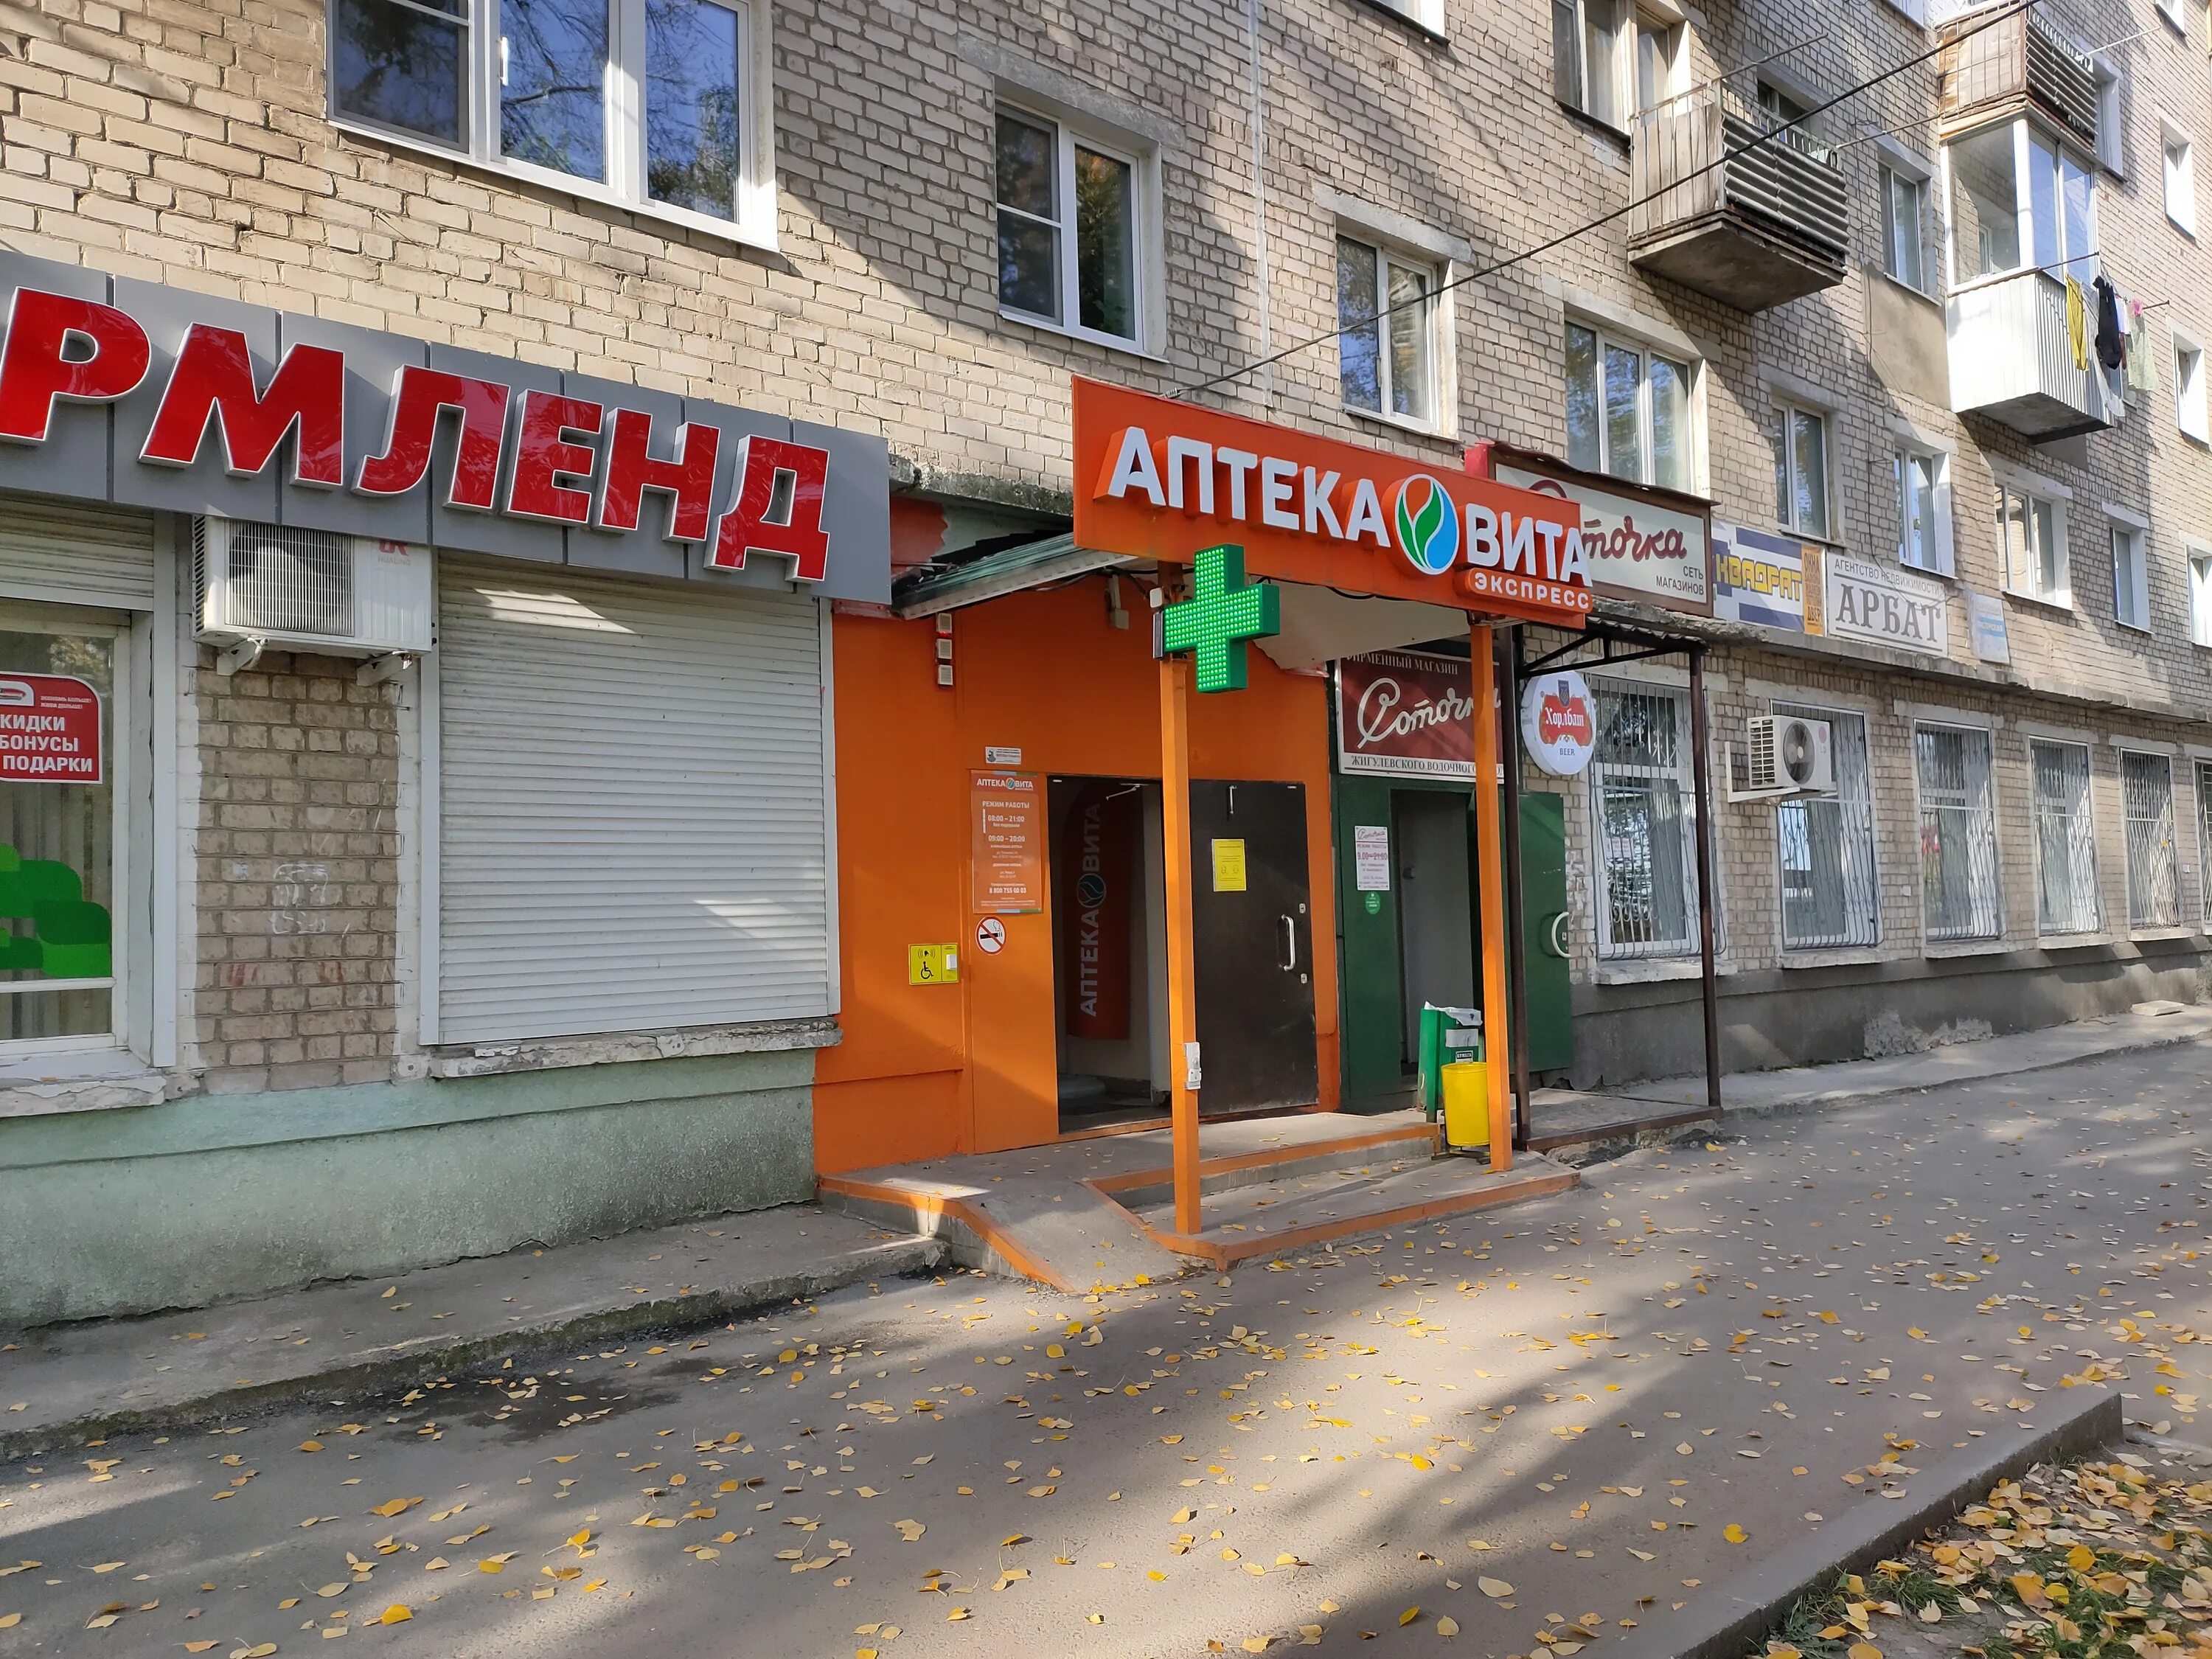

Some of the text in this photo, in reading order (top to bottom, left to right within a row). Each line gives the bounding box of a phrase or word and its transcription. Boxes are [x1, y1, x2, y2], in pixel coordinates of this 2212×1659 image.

[0, 285, 830, 583] РМЛЕНД
[1107, 425, 1593, 588] АПТЕКА ВИТА
[1683, 566, 1704, 580] СЕТЬ
[1715, 554, 1802, 602] КВАДРАТ
[1834, 559, 1879, 580] АГЕНТСТВО
[1474, 573, 1590, 611] ЭКСПРЕСС
[1656, 576, 1704, 596] МАГАЗИНОВ
[1835, 583, 1941, 642] АРБАТ
[1414, 658, 1458, 675] МАГАЗИН
[0, 714, 66, 733] КИДКИ
[0, 734, 78, 752] БОНУСЫ
[1559, 748, 1575, 756] BEER
[3, 755, 92, 773] ПОДАРКИ
[1352, 756, 1425, 770] ЖИГУЛЕВСКОГО
[977, 778, 1006, 787] АПТЕКА
[1082, 802, 1101, 872] ВИТА
[1080, 908, 1099, 1018] АПТЕКА
